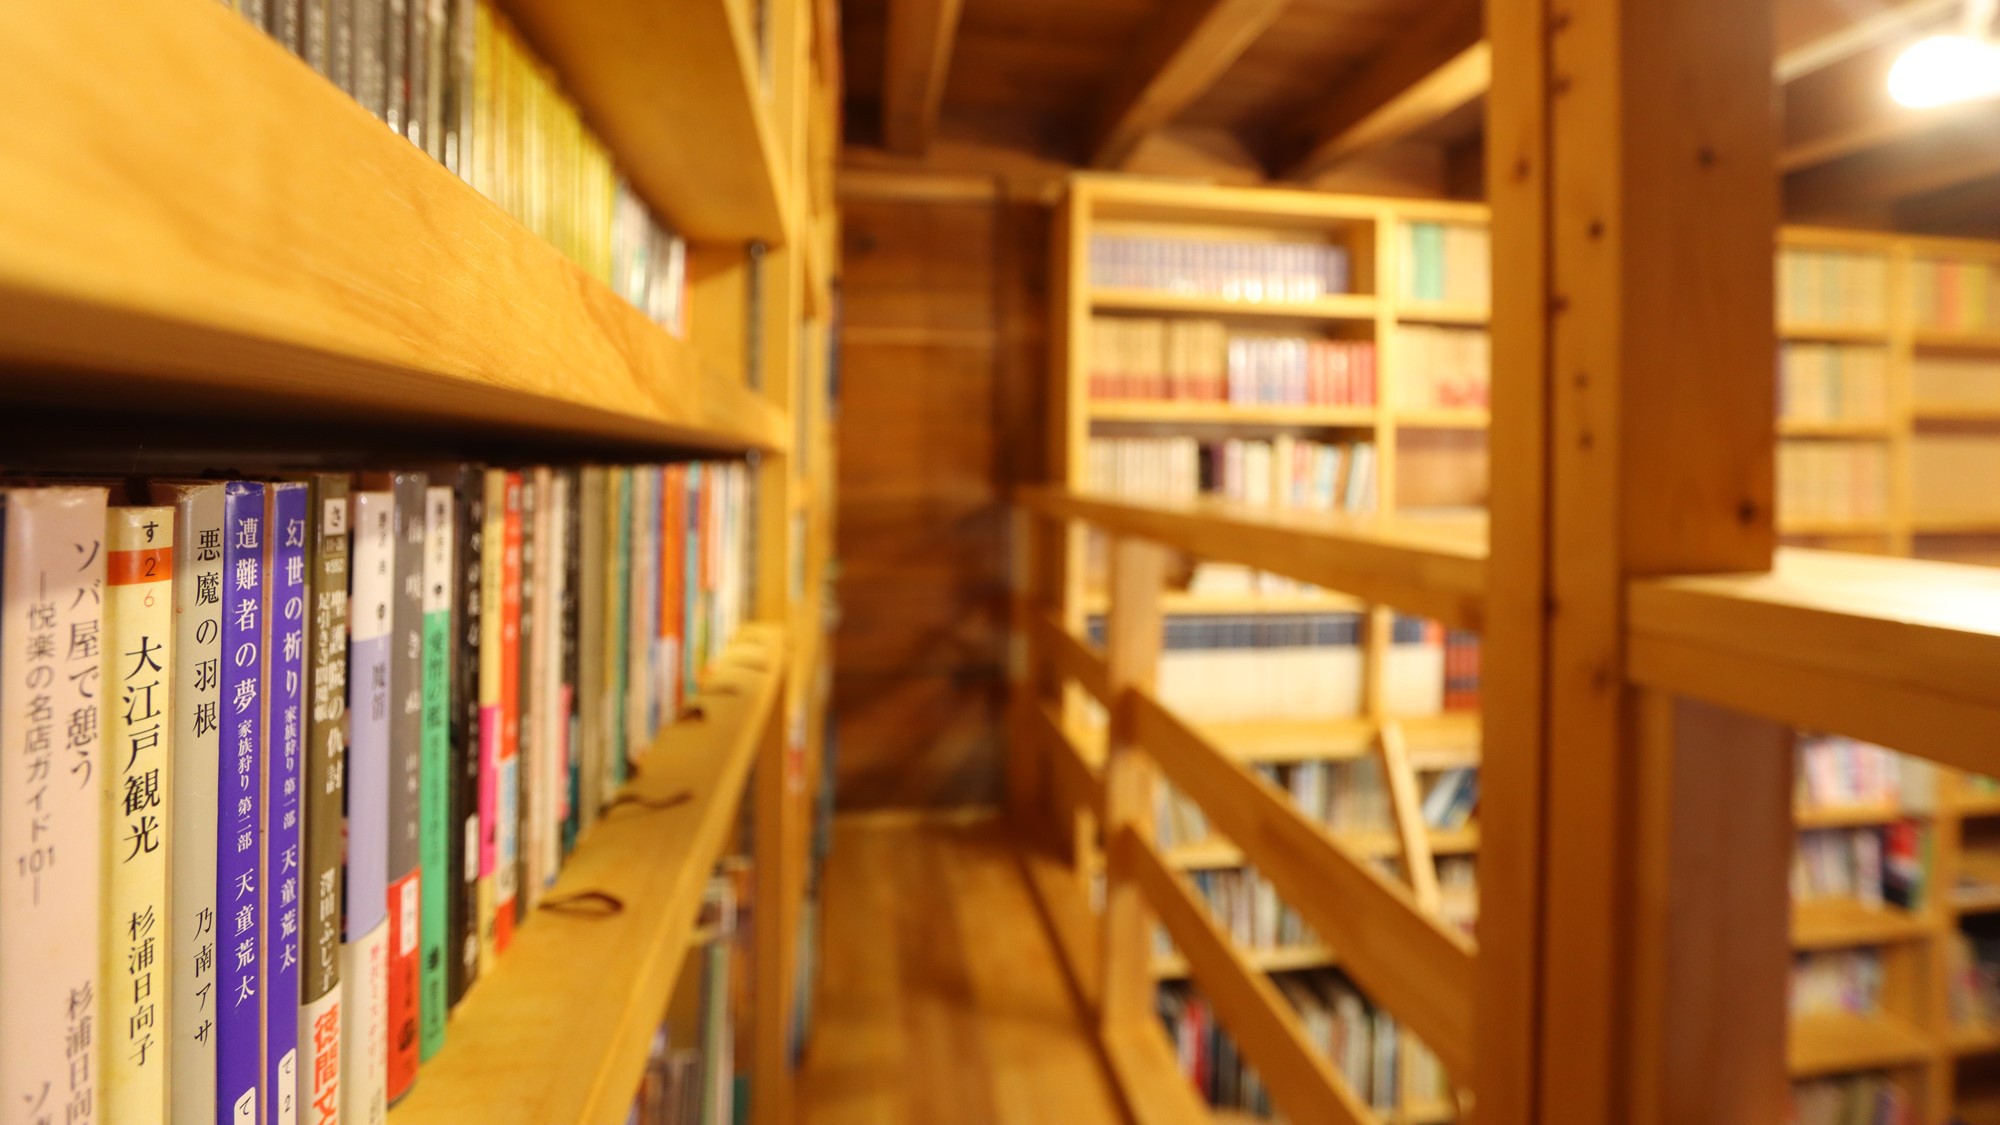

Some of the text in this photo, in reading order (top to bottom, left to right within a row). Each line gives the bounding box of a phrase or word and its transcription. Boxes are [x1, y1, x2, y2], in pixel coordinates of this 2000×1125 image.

[142, 521, 159, 608] す 2 6
[192, 528, 221, 738] 悪魔の羽根
[232, 518, 258, 715] 遭難者の夢
[283, 519, 305, 699] 幻世の祈り
[65, 540, 100, 791] ソバ屋で憩う
[121, 636, 162, 864] 大江戸観光
[237, 719, 253, 853] 家族狩り 第二部
[193, 907, 213, 1048] 乃南アサ
[234, 868, 255, 1008] 天童荒太
[280, 844, 296, 974] 天童荒太
[65, 979, 93, 1125] 杉浦日向
[127, 905, 155, 1066] 杉浦日向子
[313, 1003, 339, 1125] 徳間文
